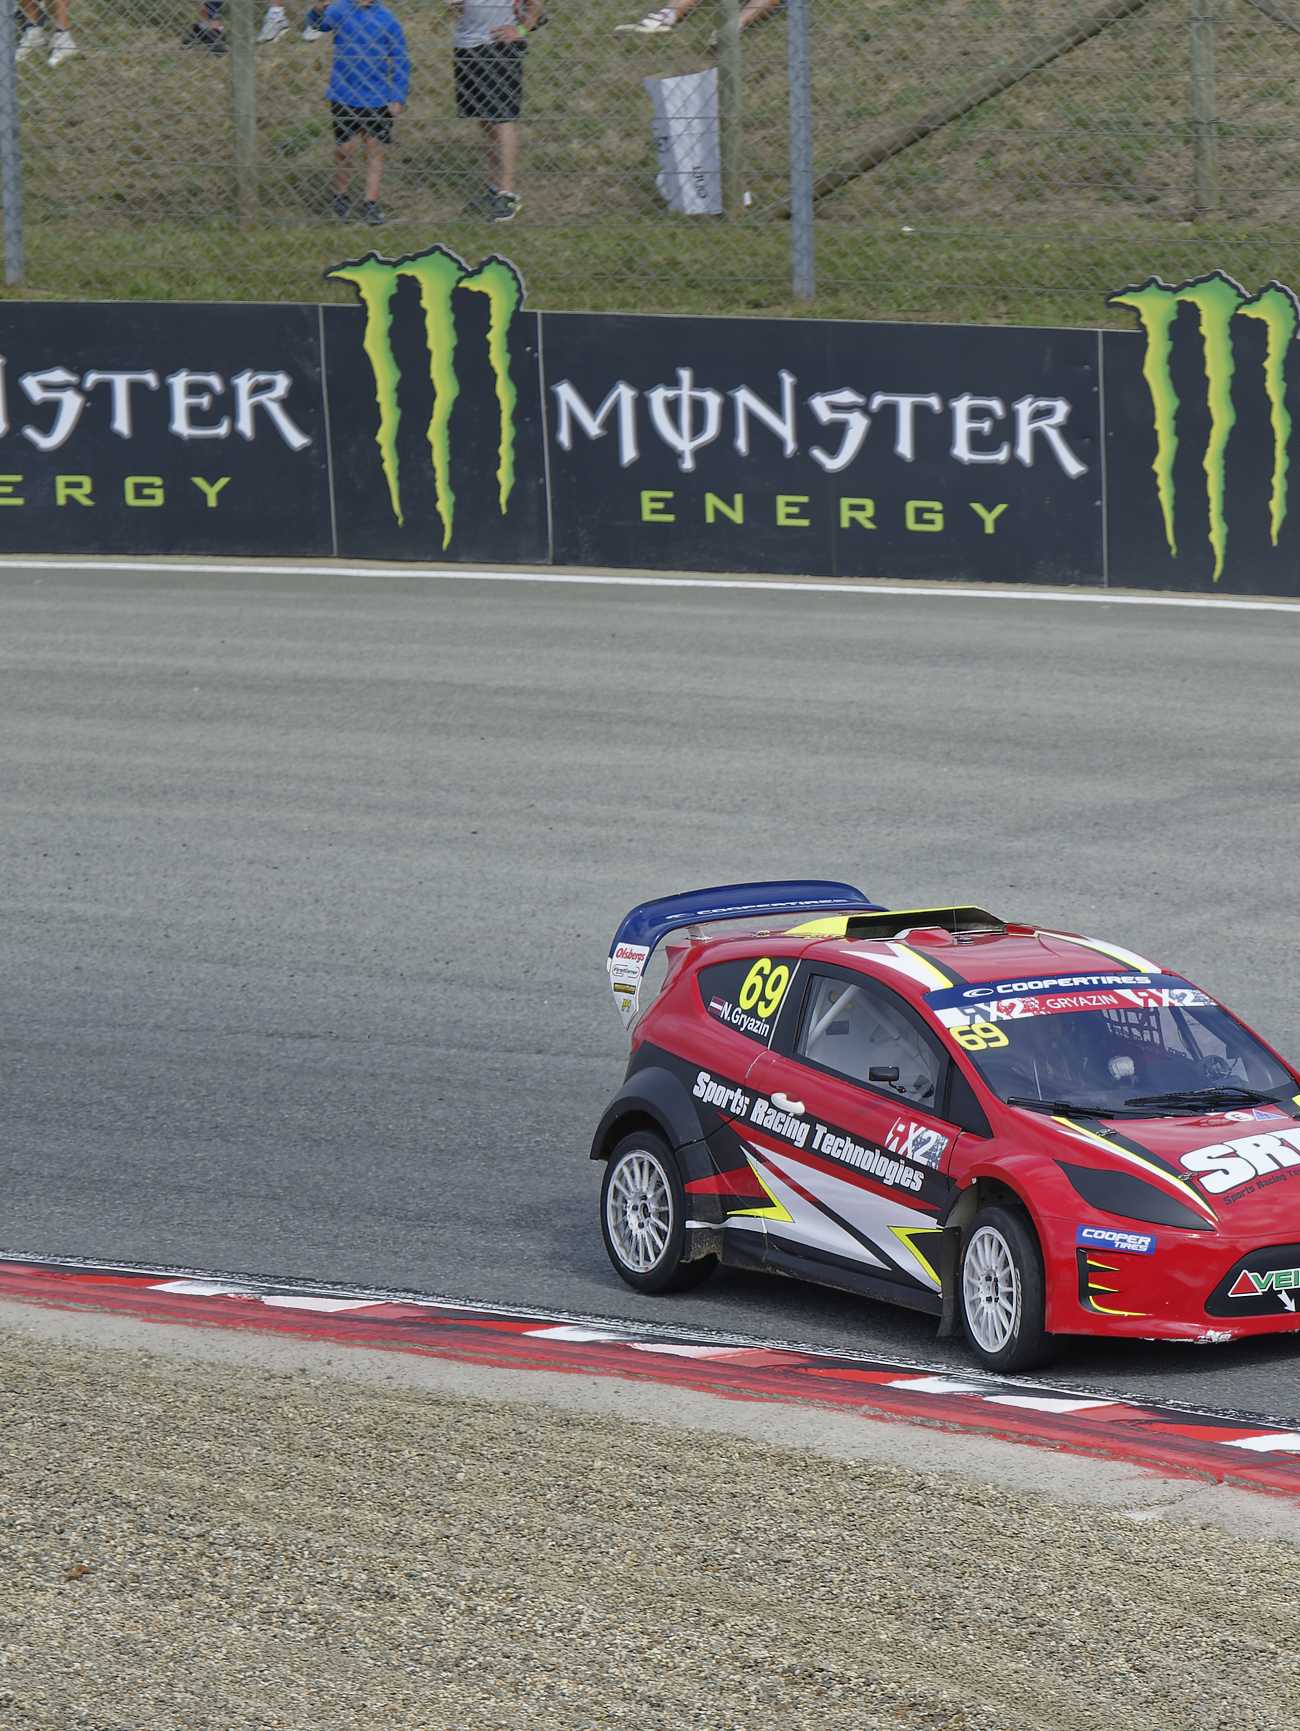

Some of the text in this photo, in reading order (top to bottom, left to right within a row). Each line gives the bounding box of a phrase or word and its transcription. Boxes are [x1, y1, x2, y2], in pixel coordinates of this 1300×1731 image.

[550, 366, 1088, 479] MONSTER
[640, 490, 1008, 534] ENERGY
[739, 957, 790, 1018] 69
[996, 975, 1152, 994] COOPERTIRES
[1046, 994, 1119, 1010] GRYAZIN
[720, 1001, 770, 1038] N.Gryazin
[949, 1022, 1009, 1051] 69
[692, 1071, 925, 1193] Sports Racing Technologies
[1081, 1228, 1152, 1247] COOPER
[1114, 1241, 1148, 1252] TIRES
